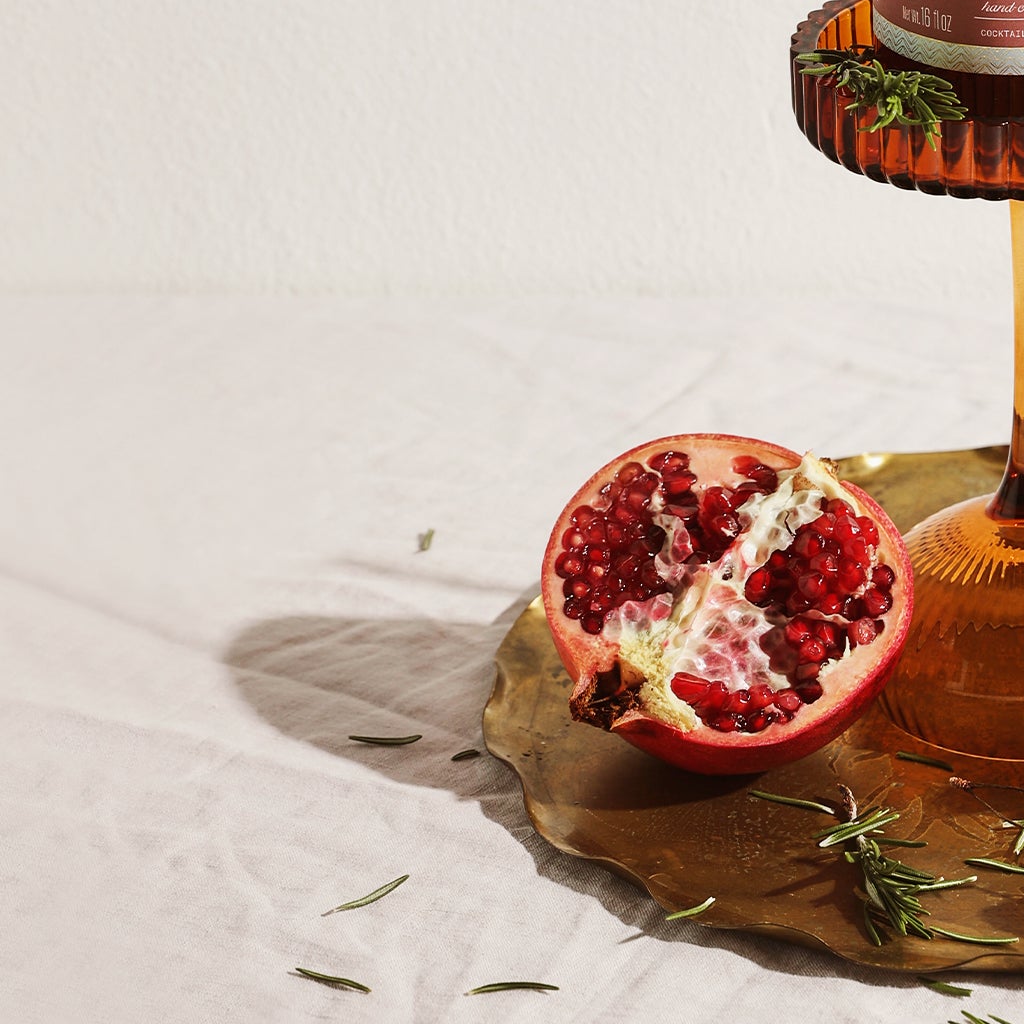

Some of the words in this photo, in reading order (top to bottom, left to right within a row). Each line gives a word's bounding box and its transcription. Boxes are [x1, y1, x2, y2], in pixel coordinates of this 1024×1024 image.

[921, 6, 931, 28] 16
[933, 9, 940, 30] fl
[941, 14, 952, 33] oz
